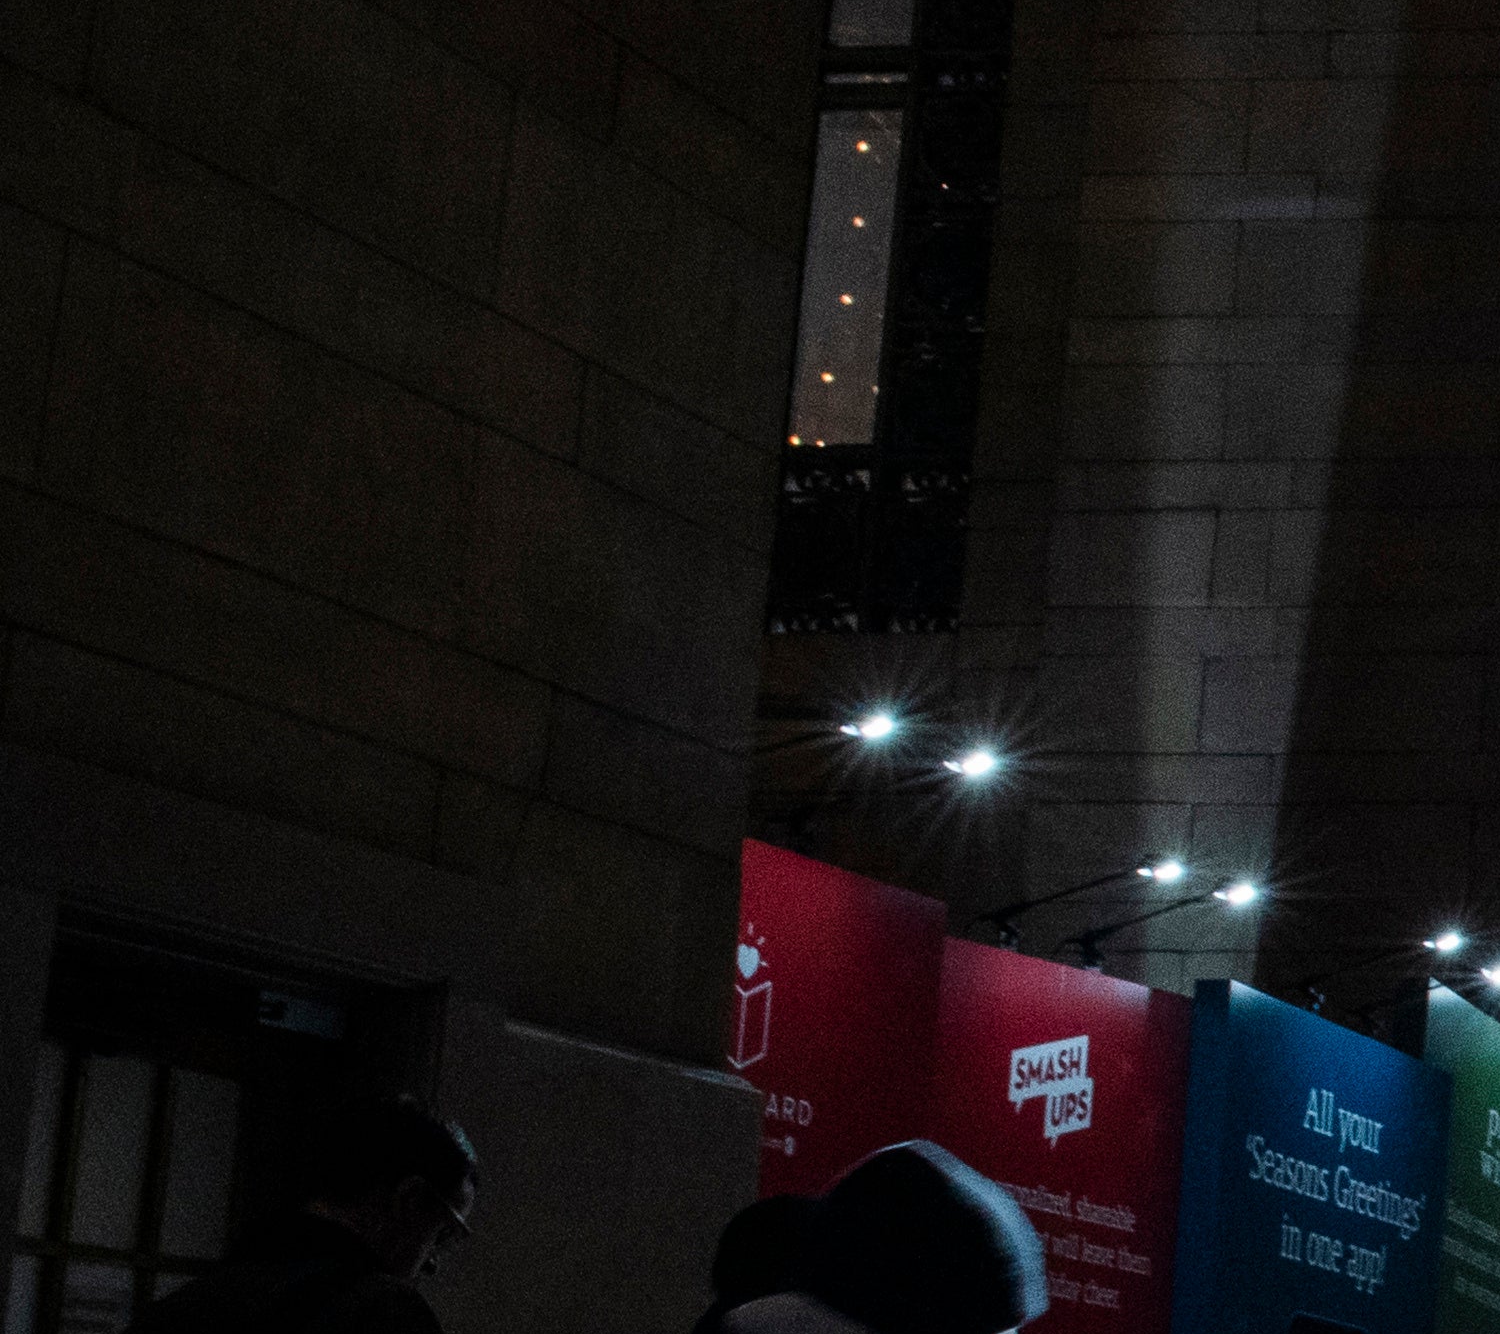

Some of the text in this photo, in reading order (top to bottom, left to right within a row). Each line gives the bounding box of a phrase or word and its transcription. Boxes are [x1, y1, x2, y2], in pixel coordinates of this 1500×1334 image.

[1014, 1045, 1082, 1090] SMASH
[763, 1091, 814, 1128] ARD
[1050, 1088, 1089, 1127] UPS
[1302, 1086, 1384, 1154] All your
[1280, 1212, 1303, 1262] in
[1306, 1231, 1344, 1274] one
